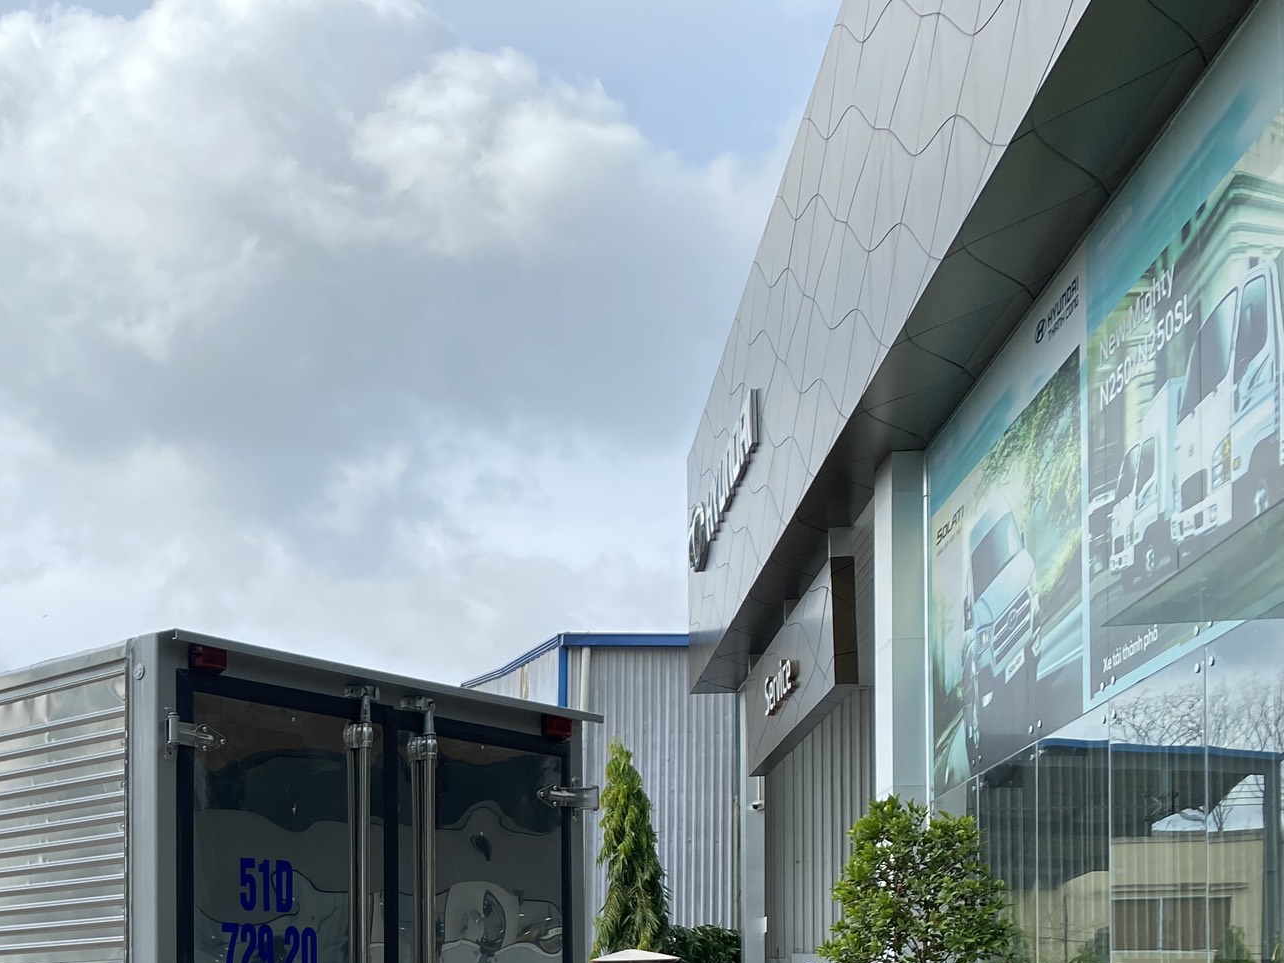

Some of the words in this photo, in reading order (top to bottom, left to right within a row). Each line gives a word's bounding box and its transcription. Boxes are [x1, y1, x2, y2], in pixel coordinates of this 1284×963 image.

[1048, 275, 1079, 328] HYUNDAI
[1099, 323, 1126, 367] New
[1128, 264, 1175, 335] Mighty
[936, 504, 965, 547] SOLATI
[1102, 656, 1112, 673] Xe
[1113, 646, 1122, 667] tải
[1122, 635, 1143, 661] thành
[1143, 624, 1158, 651] phố
[765, 659, 792, 717] Service
[240, 857, 294, 914] 51D
